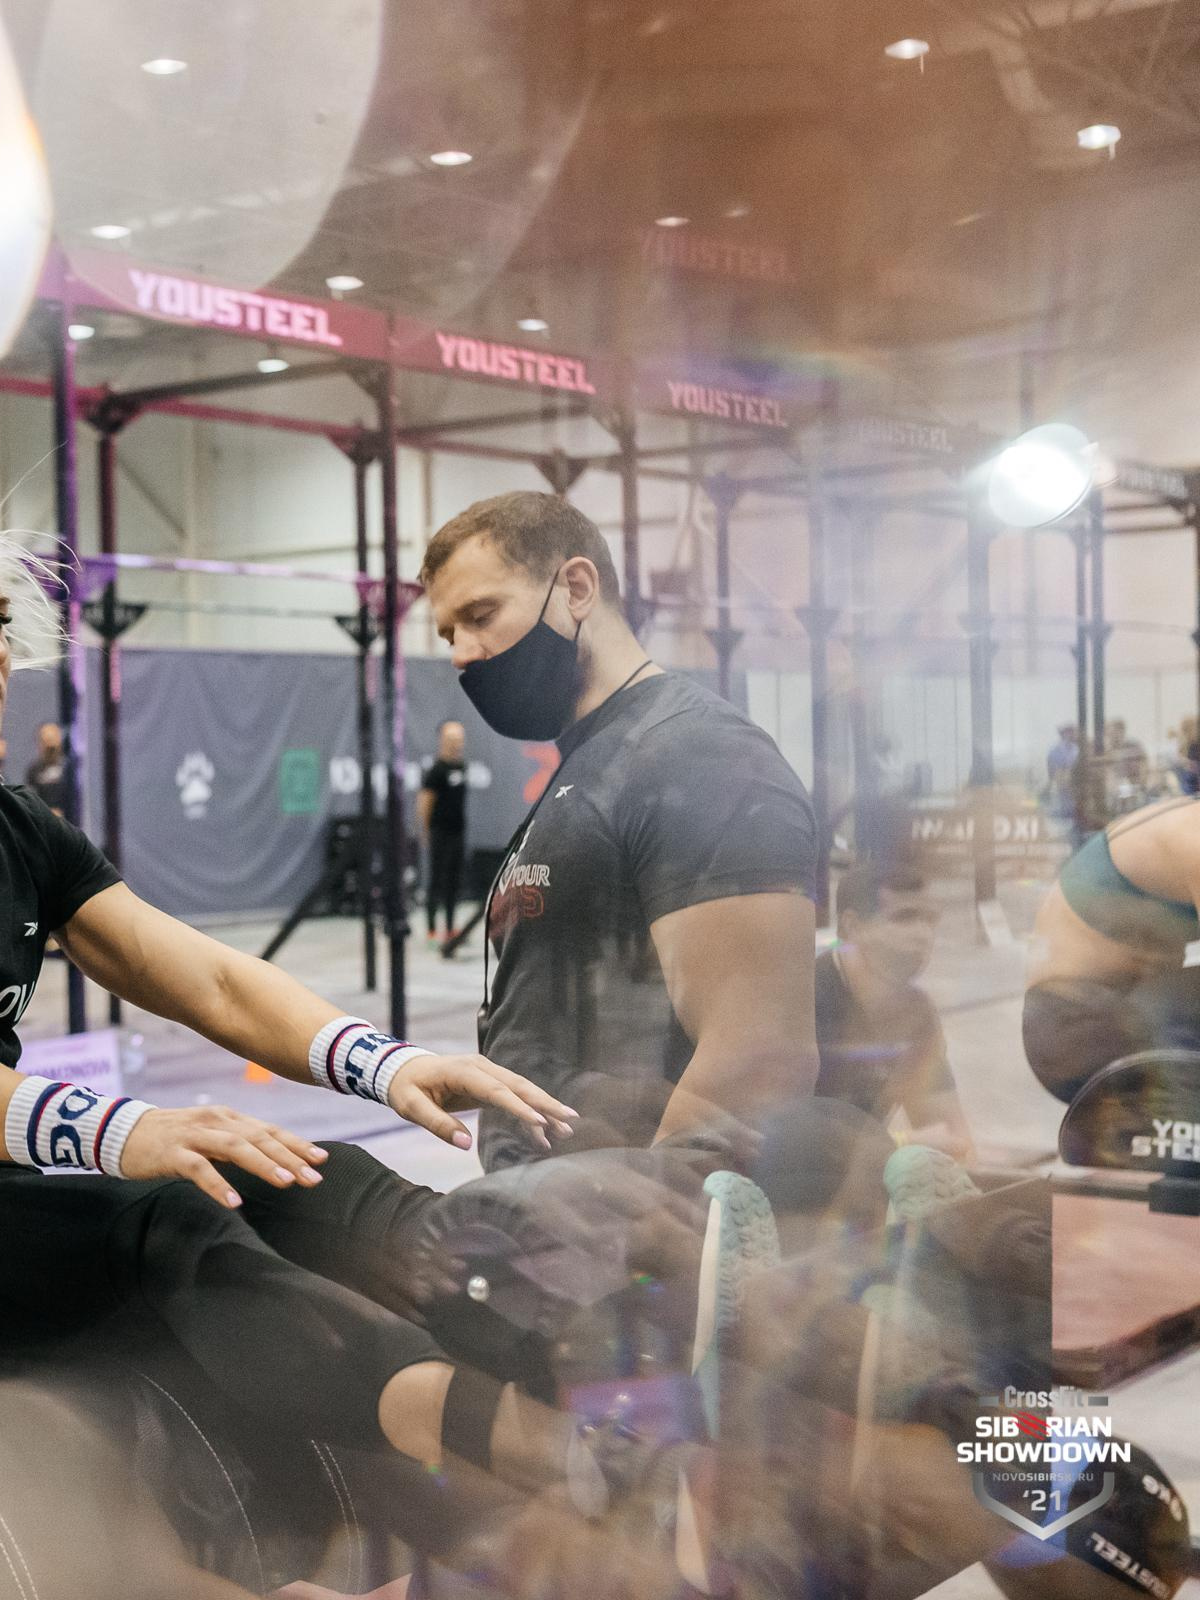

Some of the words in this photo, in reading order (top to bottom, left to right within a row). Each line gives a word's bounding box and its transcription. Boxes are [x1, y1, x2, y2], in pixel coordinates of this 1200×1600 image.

[128, 268, 343, 347] YOUSTEEL
[436, 331, 597, 396] YOUSTEEL
[666, 379, 789, 428] YOUSTEEL
